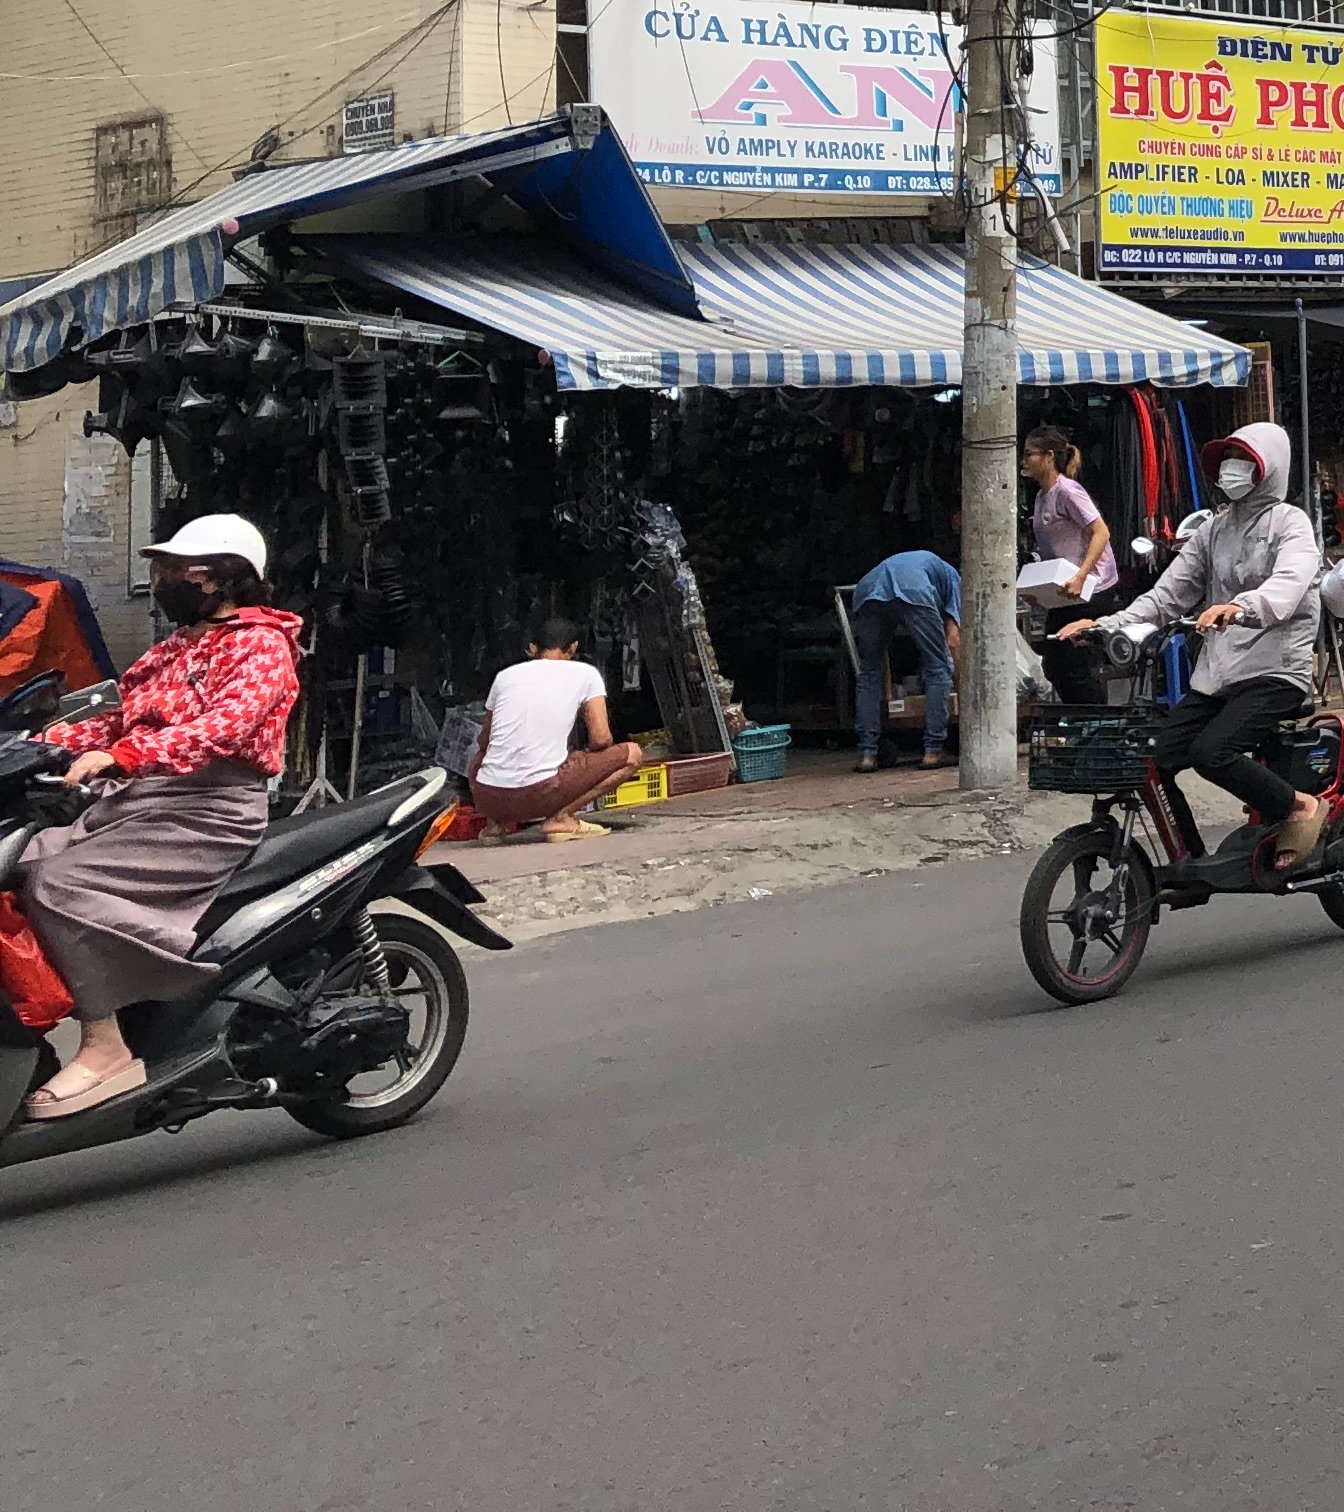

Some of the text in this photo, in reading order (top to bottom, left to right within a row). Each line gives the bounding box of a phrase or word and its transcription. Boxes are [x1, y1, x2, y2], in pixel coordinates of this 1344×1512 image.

[644, 1, 951, 62] CỬA HÀNG ĐIỆN
[1217, 35, 1343, 65] ĐIỆN TỬ
[1108, 59, 1235, 137] HUỆ
[705, 129, 730, 156] VỎ
[736, 137, 798, 159] AMPLY
[804, 140, 886, 161] KARAOKE
[903, 143, 941, 162] LINH
[1138, 138, 1186, 157] CHUYÊN
[1189, 142, 1222, 159] CUNG
[1266, 148, 1275, 162] &
[1294, 146, 1316, 164] CÁC
[654, 166, 672, 183] LÔ
[675, 170, 684, 184] R
[696, 170, 720, 185] C/C
[723, 165, 772, 186] NGUYỄN
[775, 172, 798, 187] KIM
[803, 174, 829, 188] P.7
[844, 175, 871, 190] Q.10
[888, 175, 907, 190] ĐT:
[1107, 161, 1199, 184] AMPLIFIER
[1215, 167, 1246, 186] LOA
[1262, 169, 1311, 189] MIXER
[1109, 189, 1133, 218] ĐỘC
[1263, 196, 1324, 220] Deluxe
[1121, 249, 1142, 263] 022
[1157, 251, 1164, 264] R
[1220, 253, 1237, 265] KIM
